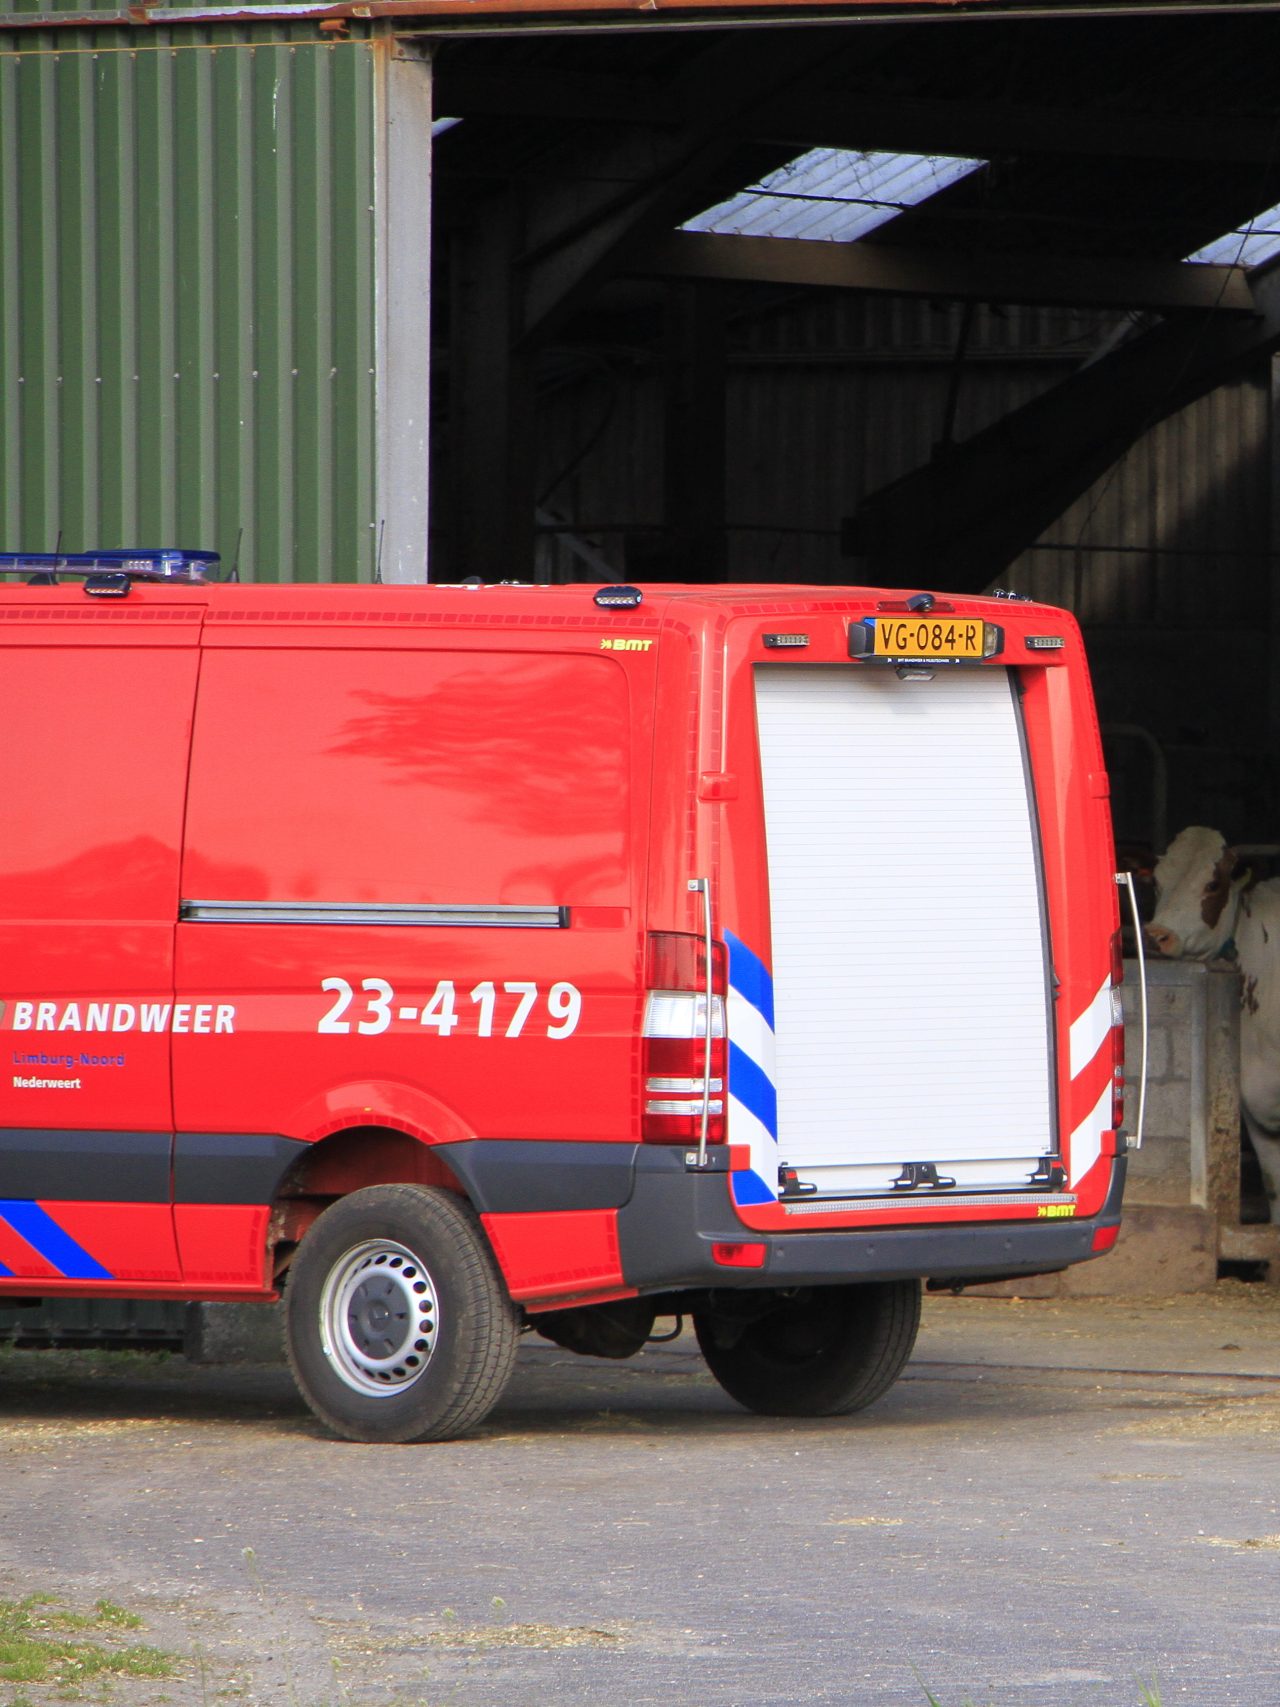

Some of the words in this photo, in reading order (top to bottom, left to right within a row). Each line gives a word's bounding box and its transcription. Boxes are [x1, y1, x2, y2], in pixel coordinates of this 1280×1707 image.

[612, 638, 653, 651] BMT
[881, 623, 976, 650] VG-084-R
[317, 977, 581, 1040] 23-4179
[12, 1001, 236, 1034] BRANDWEER
[12, 1051, 126, 1068] Limburg-Noord
[13, 1076, 81, 1089] Nederweert
[1046, 1204, 1076, 1217] BMT
